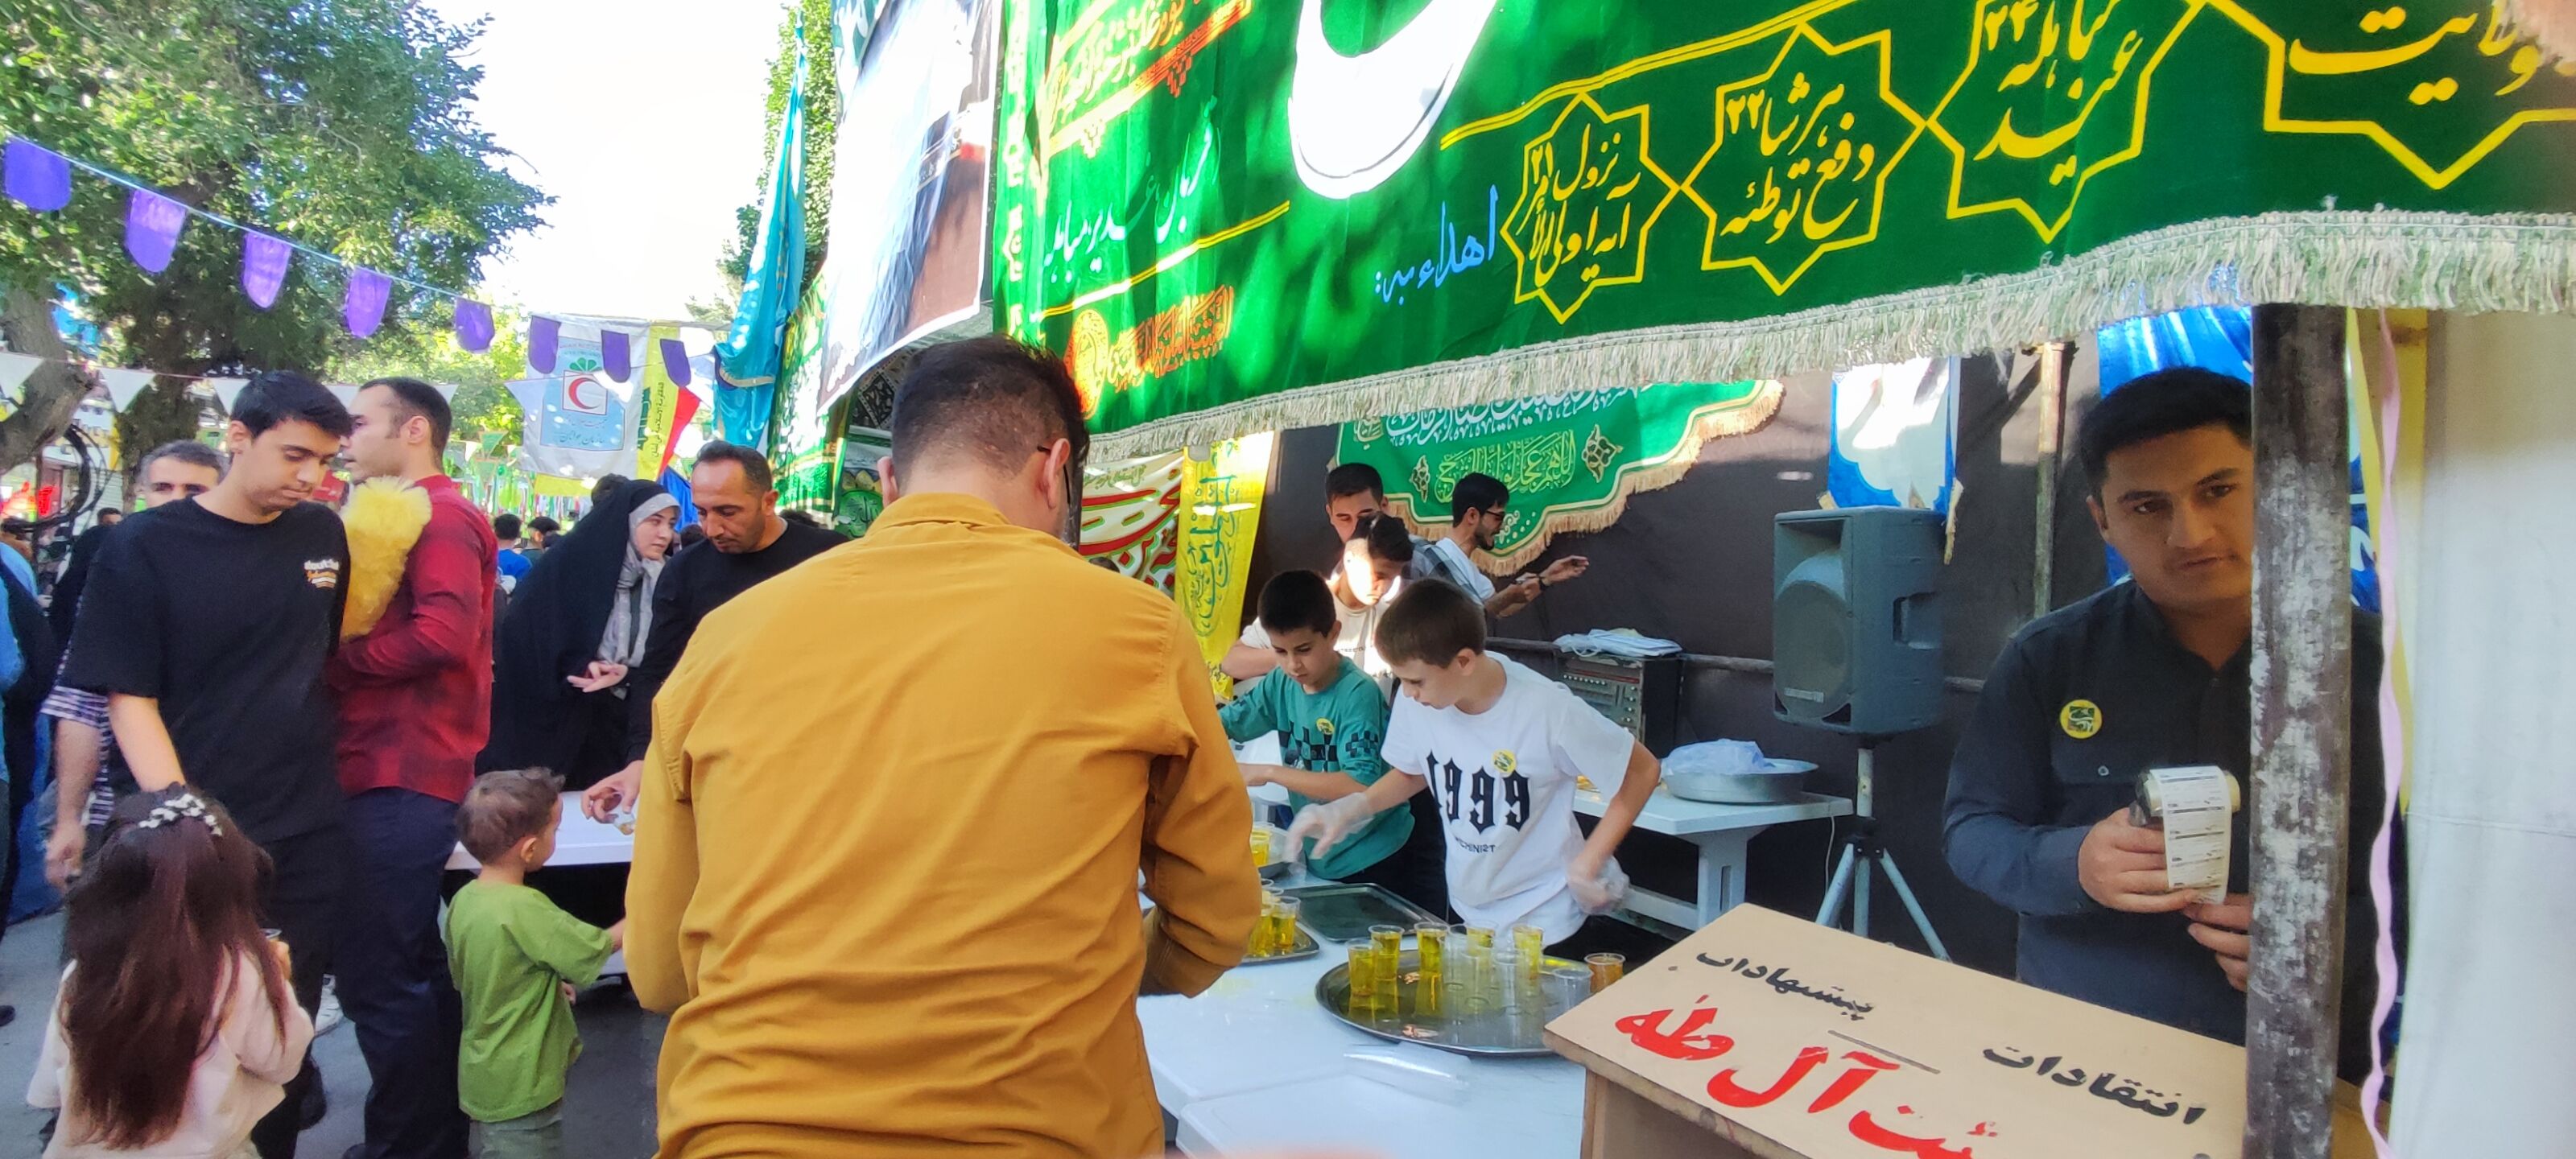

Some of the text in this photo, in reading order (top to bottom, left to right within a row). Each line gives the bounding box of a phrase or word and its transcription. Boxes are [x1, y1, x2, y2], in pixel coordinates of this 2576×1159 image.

[1726, 89, 1765, 134] ۲۲
[1974, 30, 2143, 185] عید
[1553, 123, 1621, 200] نزول
[1803, 112, 1875, 240] دفع
[1426, 749, 1531, 835] 1999
[1706, 1046, 1901, 1114] آل
[1983, 1046, 2207, 1125] انتقادات
